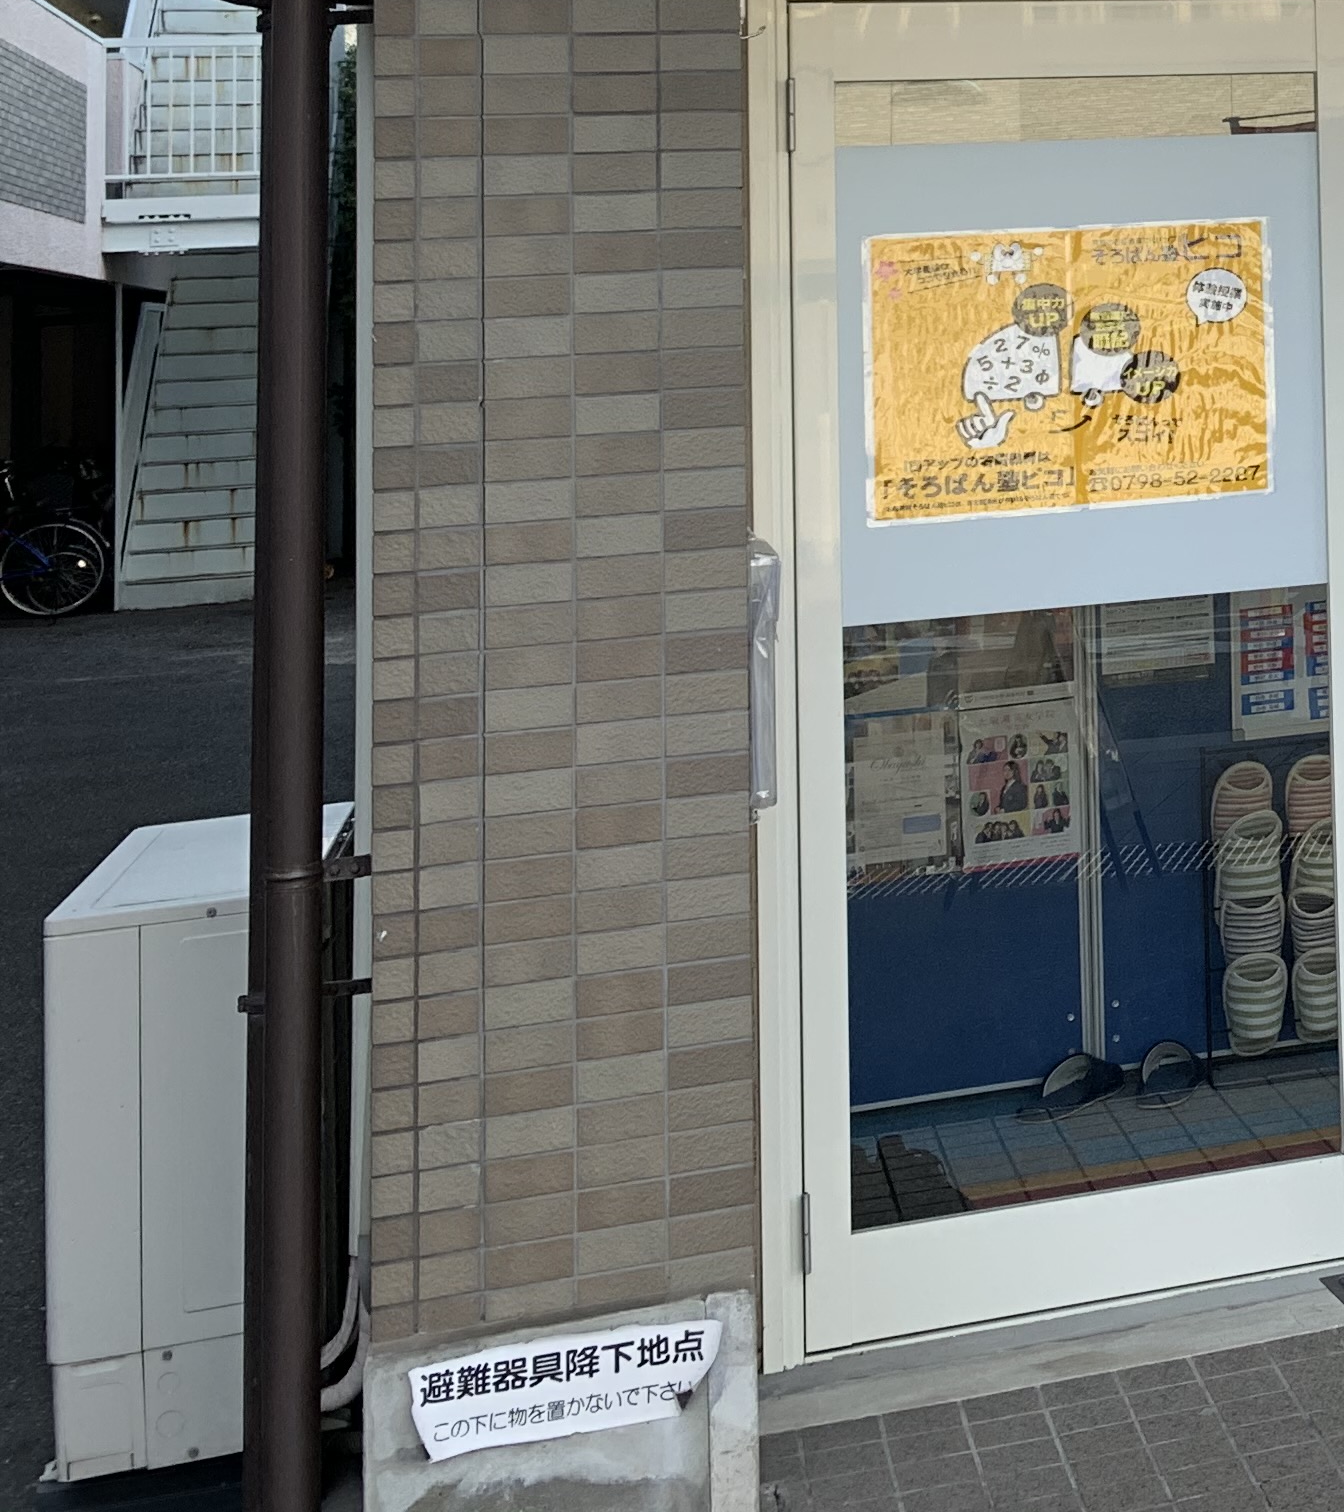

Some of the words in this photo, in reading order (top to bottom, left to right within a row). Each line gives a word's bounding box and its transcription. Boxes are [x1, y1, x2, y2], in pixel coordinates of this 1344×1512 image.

[1028, 311, 1060, 328] UP
[1110, 464, 1261, 492] 0798-52-2227
[419, 1329, 706, 1408] 避難器具降下地点
[432, 1380, 694, 1443] この下に物を置かないで下さい
